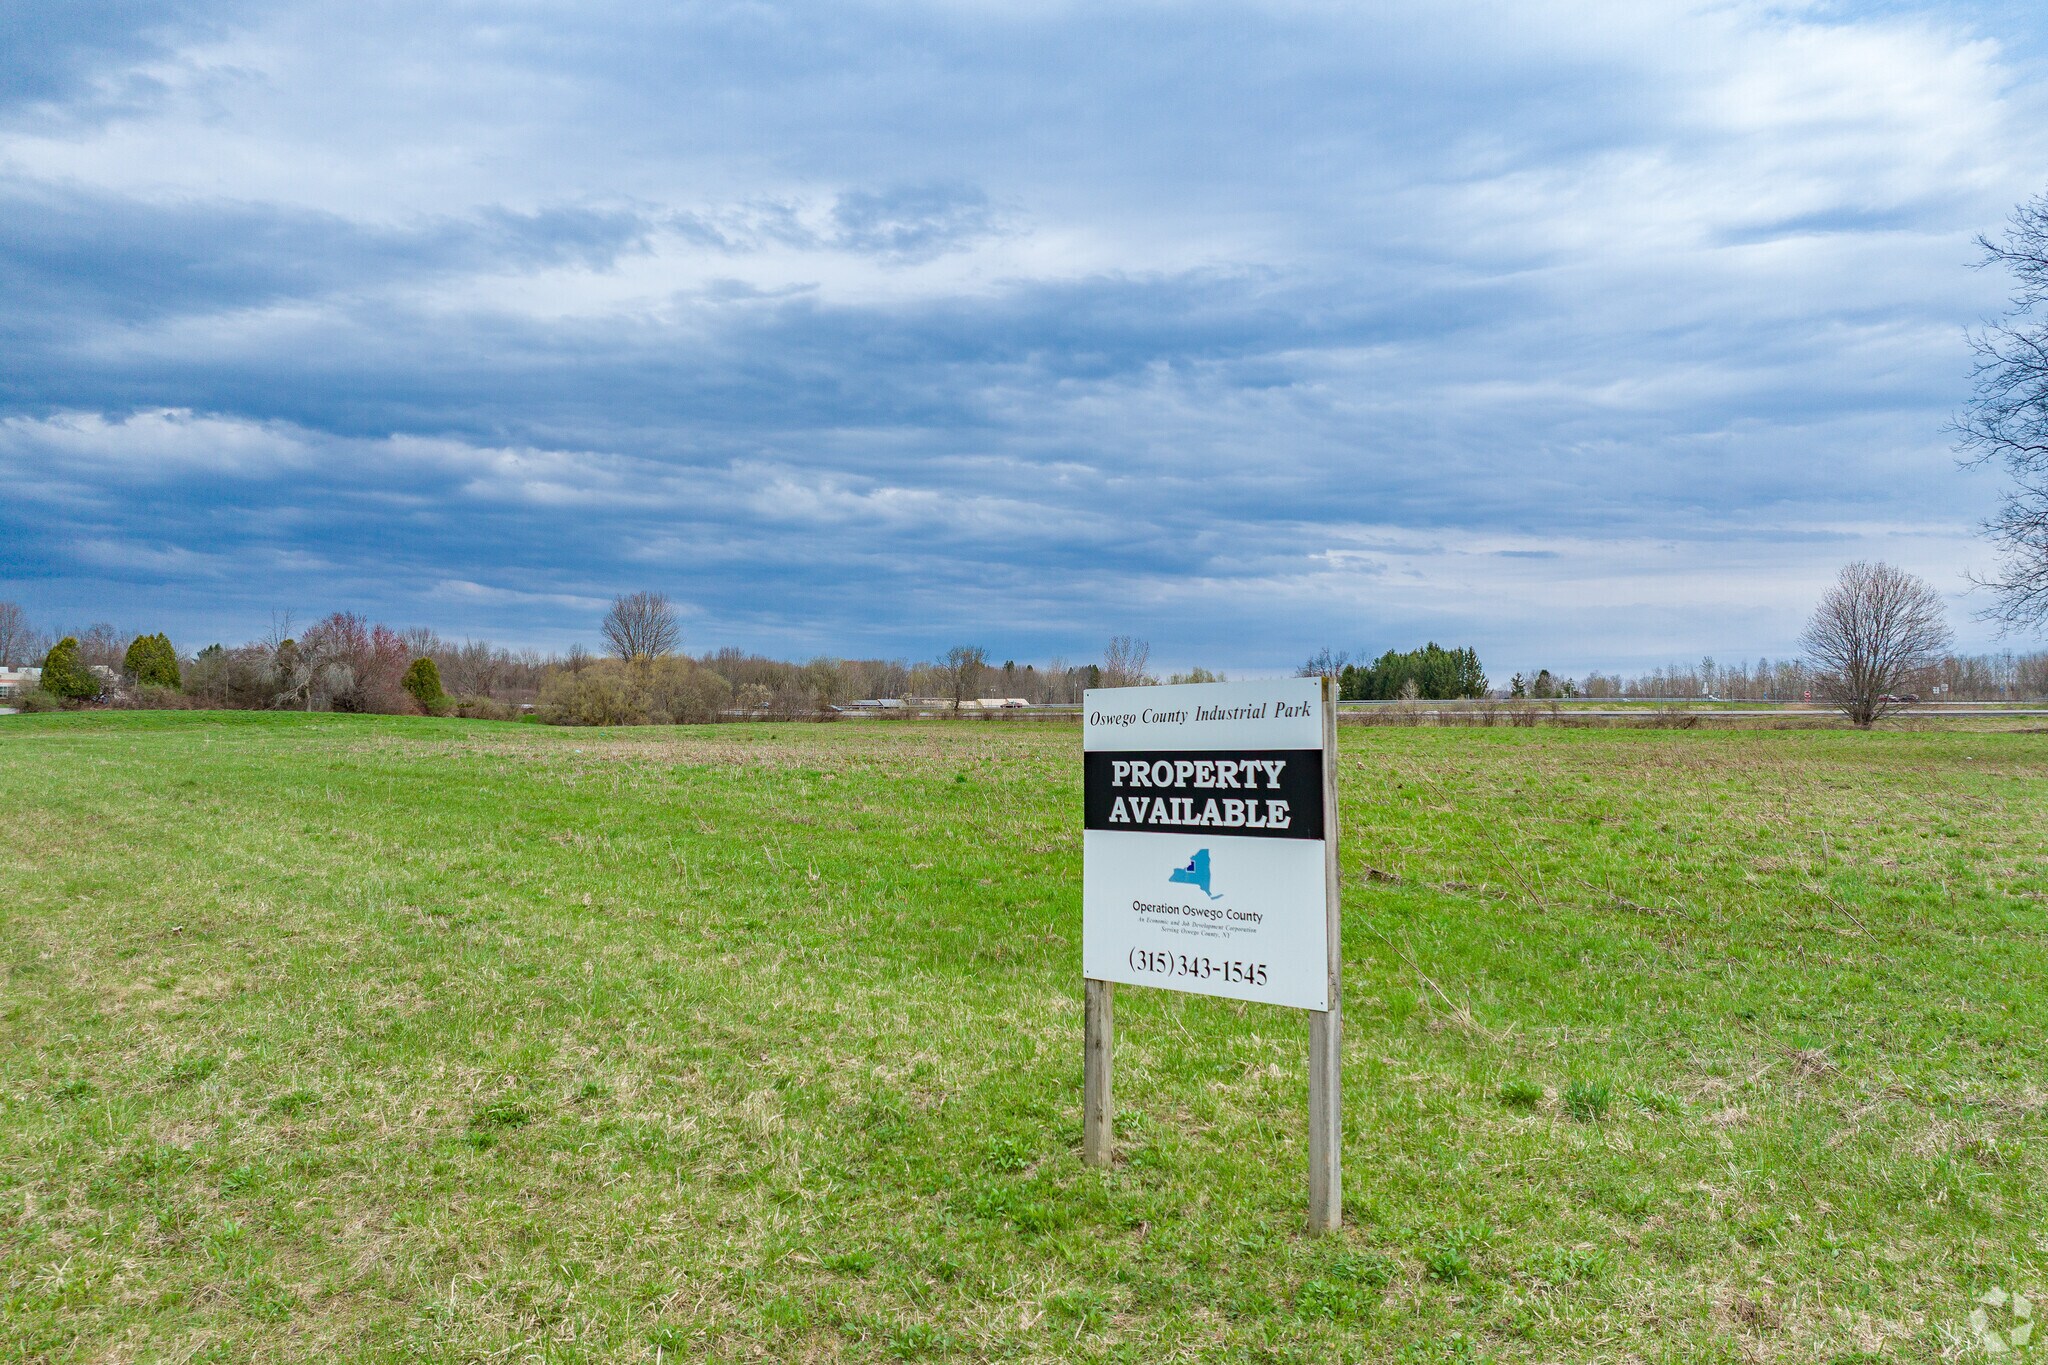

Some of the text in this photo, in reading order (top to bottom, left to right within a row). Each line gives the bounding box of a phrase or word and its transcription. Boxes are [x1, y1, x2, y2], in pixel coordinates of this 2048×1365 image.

[1090, 700, 1311, 728] Oswego County Industrial Park
[1111, 759, 1286, 789] PROPERTY
[1109, 796, 1291, 829] AVAILABLE
[1132, 900, 1263, 925] Operation Oswego County
[1146, 917, 1169, 925] Economic
[1192, 921, 1224, 931] Development
[1225, 924, 1257, 934] Corporation
[1160, 926, 1179, 934] Serving
[1180, 928, 1200, 936] Oswego
[1222, 931, 1230, 939] NY
